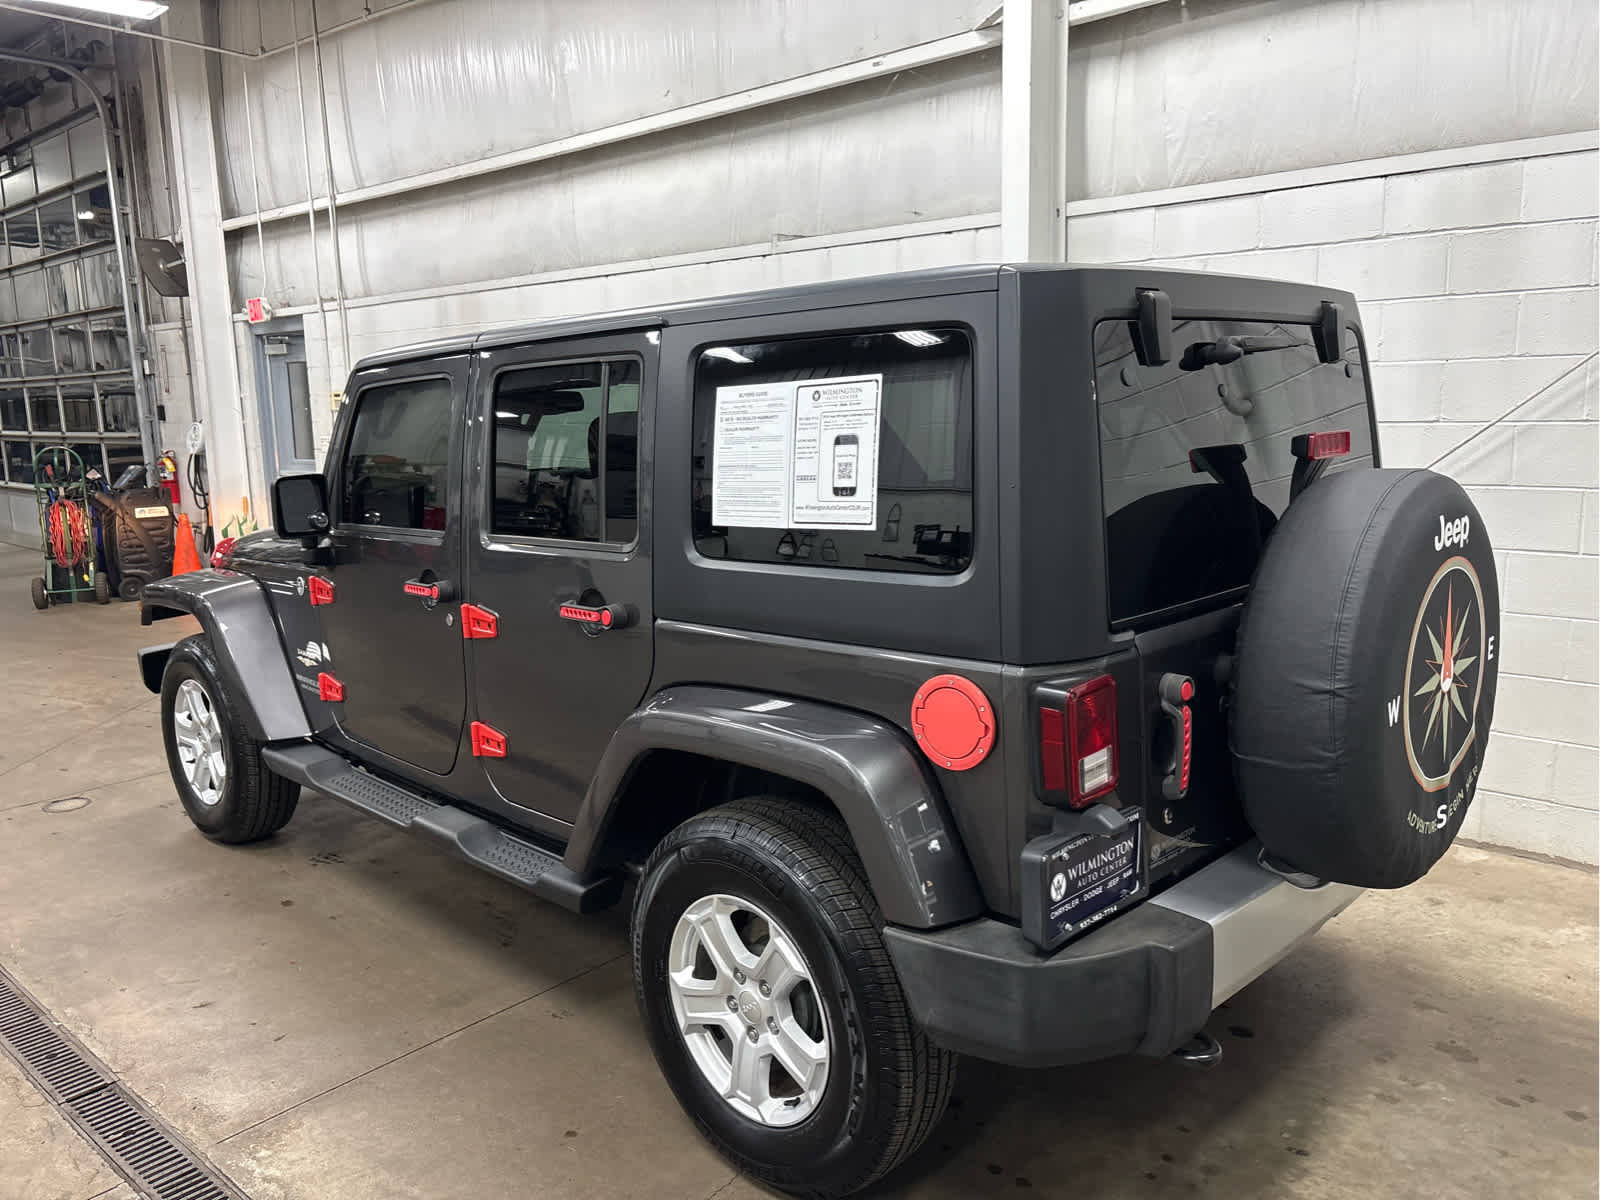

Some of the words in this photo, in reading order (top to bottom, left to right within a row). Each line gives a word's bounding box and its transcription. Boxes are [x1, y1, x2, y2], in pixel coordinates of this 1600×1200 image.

[1434, 514, 1469, 551] Jeep
[1487, 635, 1495, 661] E
[1388, 695, 1401, 728] W
[1067, 836, 1135, 880] WILMINGTON
[1077, 871, 1099, 889] AUTO
[1100, 855, 1128, 877] CENTER
[1050, 898, 1080, 920] CHRYSLER
[1083, 885, 1103, 902] DODGE
[1106, 876, 1120, 889] JEEP
